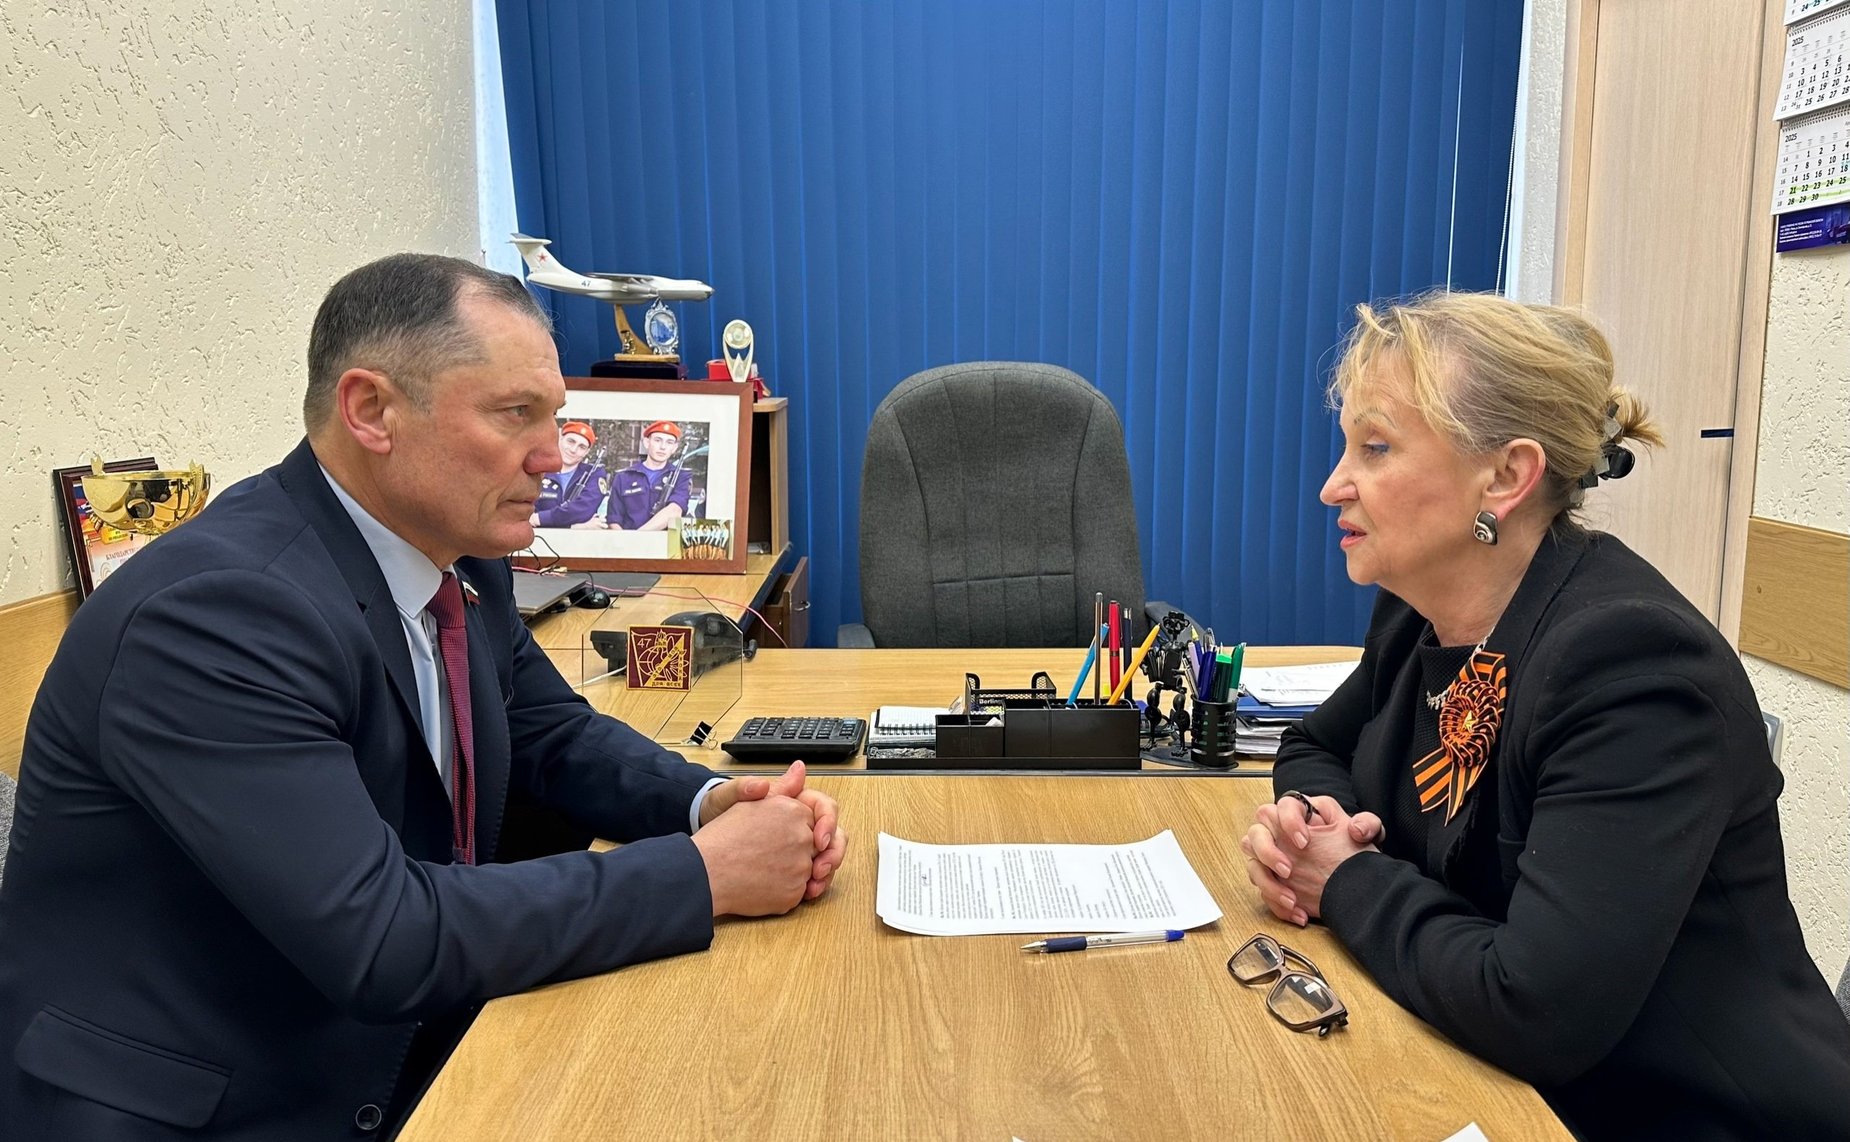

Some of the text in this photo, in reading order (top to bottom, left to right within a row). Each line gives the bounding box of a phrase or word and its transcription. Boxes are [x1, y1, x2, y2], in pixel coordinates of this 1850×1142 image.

[1792, 36, 1804, 46] 2025
[1825, 59, 1829, 67] 5
[1798, 79, 1804, 87] 10
[1809, 75, 1816, 83] 11
[1822, 70, 1829, 79] 12
[1834, 66, 1842, 75] 13
[1795, 90, 1803, 98] 17
[1808, 86, 1814, 94] 18
[1820, 82, 1827, 90] 19
[1832, 78, 1839, 87] 20
[1805, 98, 1812, 106] 25
[1817, 94, 1825, 102] 26
[1829, 90, 1837, 98] 27
[1842, 86, 1850, 94] 28
[1785, 133, 1797, 142] 2025
[1829, 156, 1836, 164] 10
[1842, 153, 1849, 161] 11
[1803, 173, 1810, 181] 15
[1815, 170, 1822, 178] 16
[1828, 167, 1835, 175] 17
[1840, 164, 1848, 173] 18
[1789, 186, 1796, 194] 21
[1813, 182, 1821, 190] 23
[1826, 179, 1834, 187] 24
[1839, 176, 1846, 184] 25
[1811, 193, 1819, 201] 30
[637, 638, 651, 648] 47
